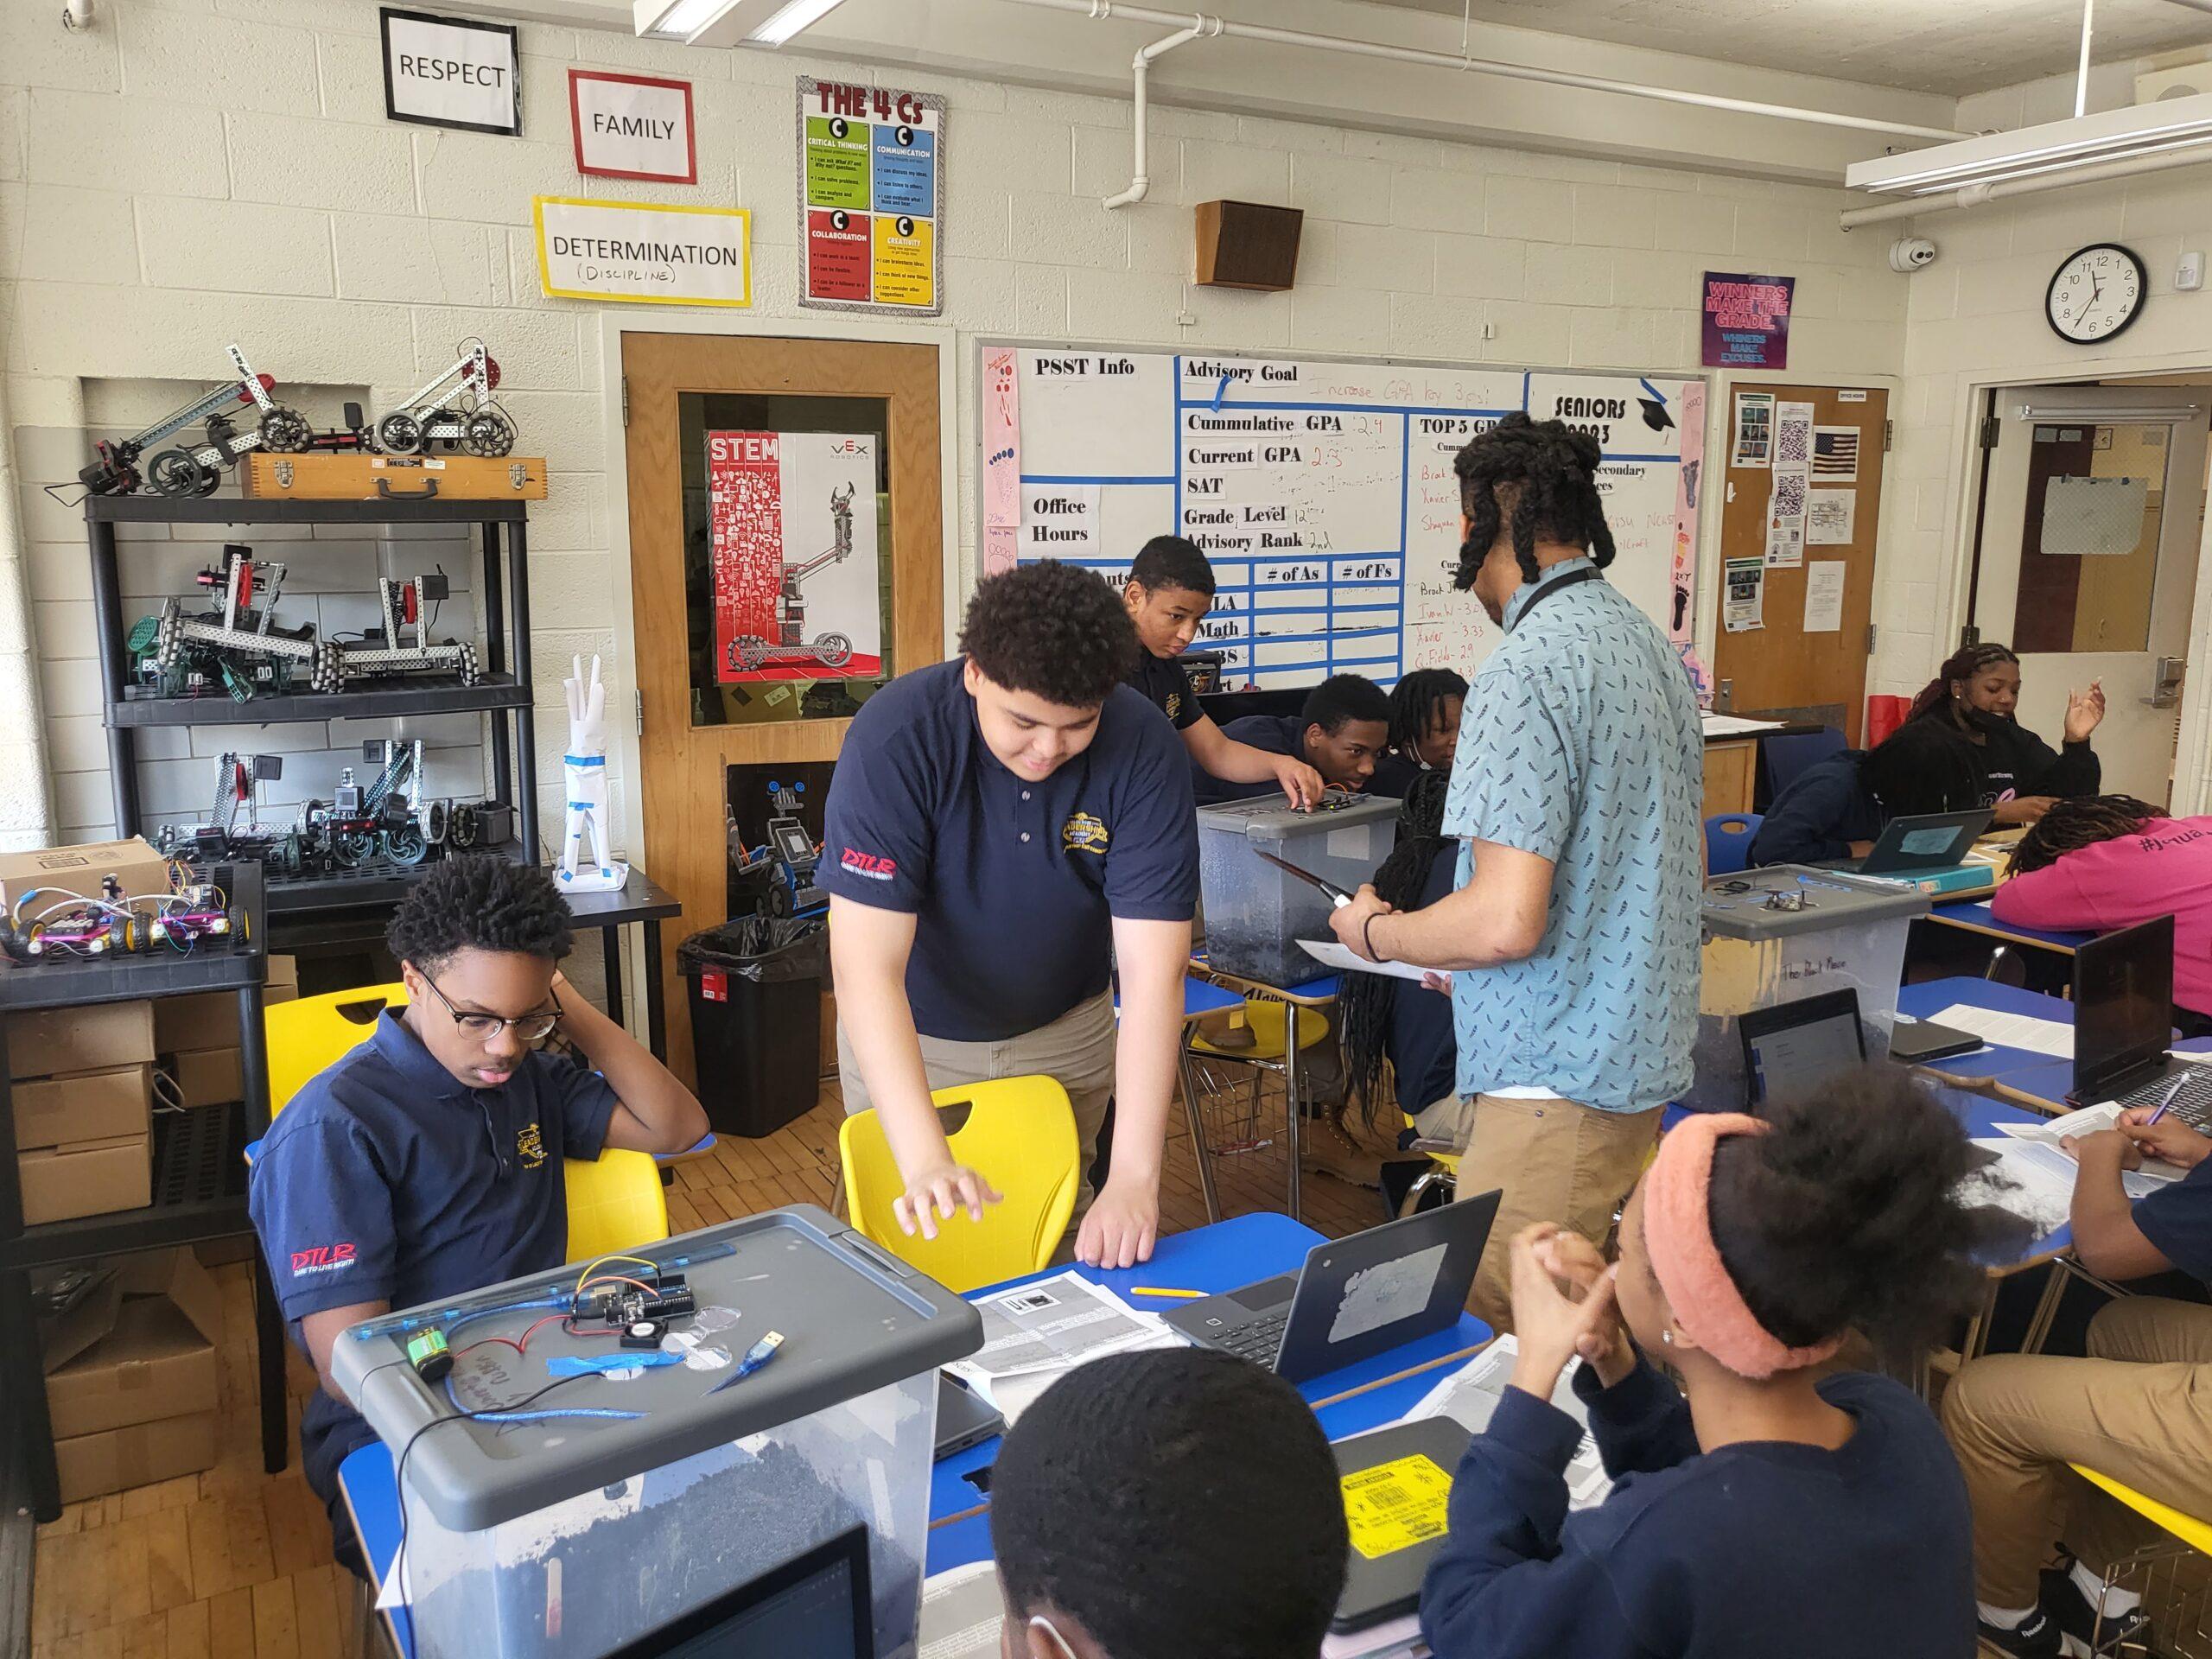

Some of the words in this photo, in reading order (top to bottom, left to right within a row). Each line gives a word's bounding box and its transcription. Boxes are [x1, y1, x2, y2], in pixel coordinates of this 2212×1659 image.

[400, 54, 505, 88] RESPECT
[817, 82, 867, 118] THE
[874, 89, 892, 121] 4
[897, 94, 924, 124] Cs
[594, 113, 675, 140] FAMILY
[808, 137, 836, 147] CRITICAL
[837, 141, 868, 150] THINKING
[877, 146, 931, 158] COMMUNICATION
[812, 230, 867, 242] COLLABORATION
[887, 237, 921, 247] CREATIVITY
[553, 236, 737, 266] DETERMINATION
[2082, 262, 2091, 272] 11
[2096, 256, 2108, 267] 12
[2115, 259, 2120, 270] 1
[2069, 275, 2080, 285] 10
[2124, 270, 2133, 280] 2
[1709, 282, 1788, 301] WINNERS
[2061, 292, 2069, 302] 9
[2126, 286, 2135, 296] 3
[1706, 296, 1753, 315] MAKE
[1758, 300, 1789, 316] THE
[2063, 308, 2070, 319] 8
[2120, 304, 2127, 315] 4
[1715, 313, 1775, 330] GRADE.
[2088, 321, 2097, 332] 6
[2105, 315, 2113, 327] 5
[1730, 344, 1758, 353] MAKE
[1035, 357, 1090, 376] PSST
[1097, 357, 1135, 376] Info
[1720, 353, 1767, 364] EXCUSES.
[1184, 360, 1255, 384] Advisory
[1262, 365, 1298, 382] Goal
[1555, 397, 1626, 419] SENIORS
[1188, 414, 1294, 432] Cummulative
[1306, 415, 1343, 432] GPA
[1420, 419, 1455, 434] TOP
[1459, 419, 1467, 434] 5
[711, 438, 779, 461] STEM
[830, 440, 868, 455] VEX
[1189, 448, 1253, 464] Current
[1264, 447, 1302, 463] GPA
[1186, 477, 1224, 494] SAT
[1033, 497, 1086, 515] Office
[1185, 509, 1234, 524] Grade
[1244, 506, 1286, 524] Level
[1033, 525, 1088, 543] Hours
[1186, 534, 1253, 554] Advisory
[1261, 531, 1303, 548] Rank
[1268, 569, 1277, 582] #
[1282, 566, 1298, 582] of
[1300, 567, 1319, 582] As
[1342, 565, 1352, 580] #
[1357, 563, 1373, 580] of
[1374, 563, 1392, 579] Fs
[1196, 620, 1239, 639] Math
[842, 847, 896, 875] DTLR
[290, 1243, 358, 1271] DTLR
